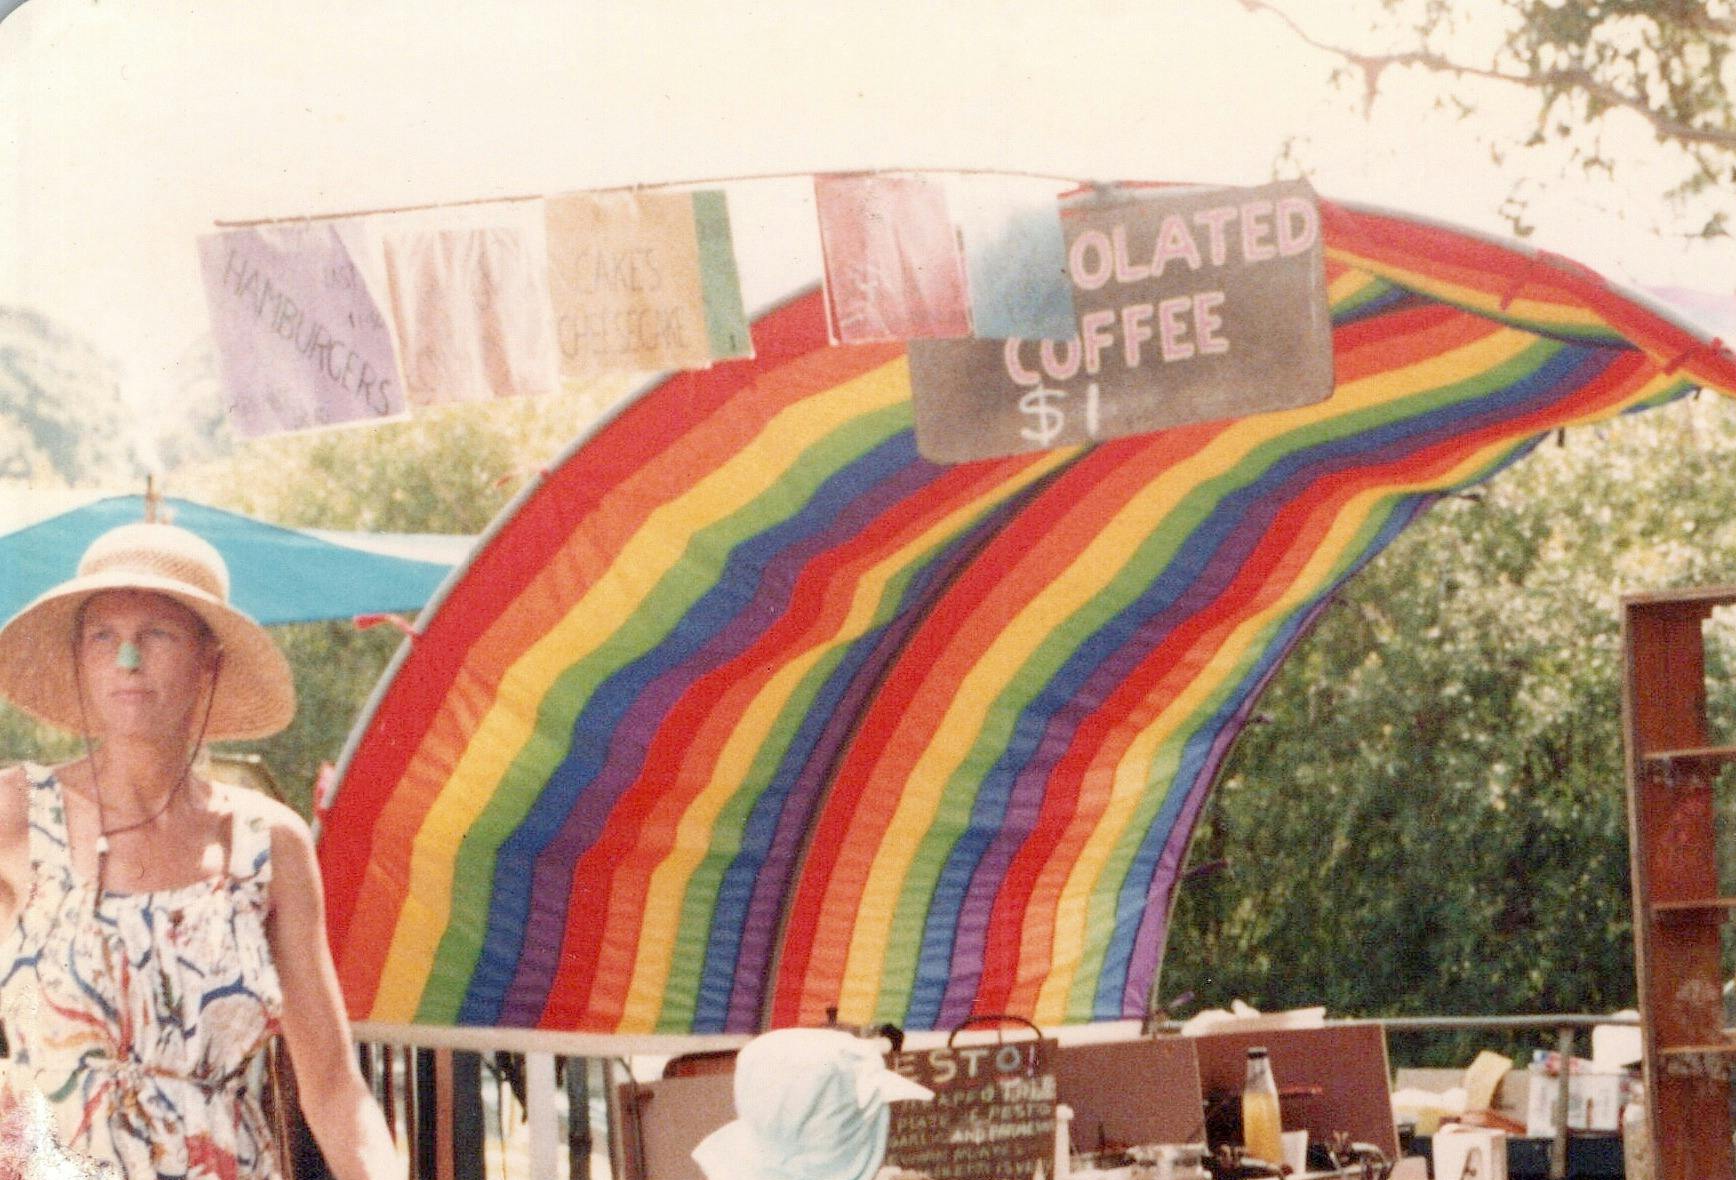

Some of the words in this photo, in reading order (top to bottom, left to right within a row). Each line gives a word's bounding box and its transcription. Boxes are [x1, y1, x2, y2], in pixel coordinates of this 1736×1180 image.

[1069, 197, 1317, 290] OLATED
[224, 249, 392, 416] HAMBURGERS
[1005, 291, 1230, 385] COFFEE
[1019, 384, 1100, 444] $1
[895, 1044, 1036, 1084] ESTO!
